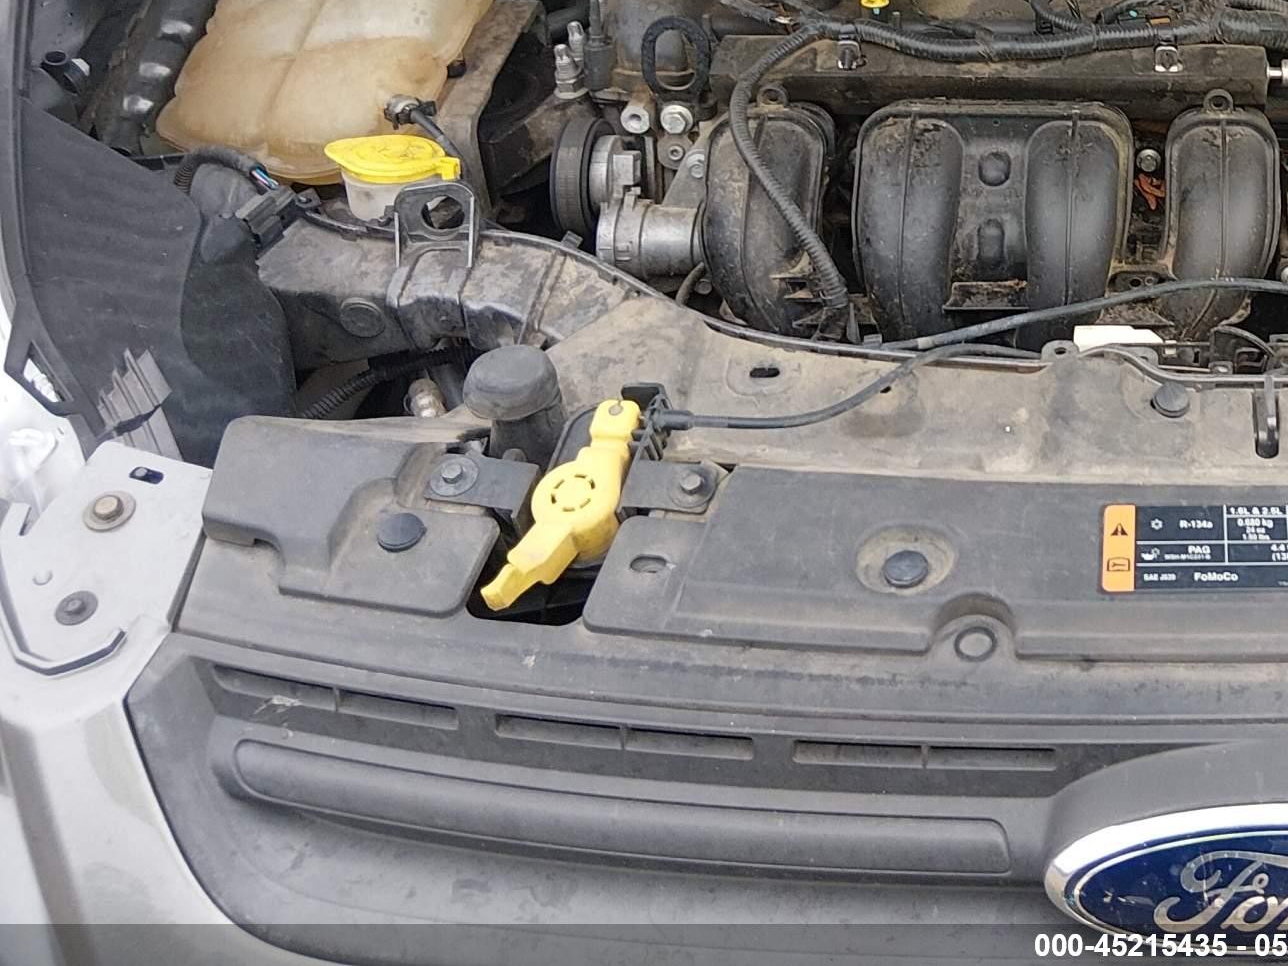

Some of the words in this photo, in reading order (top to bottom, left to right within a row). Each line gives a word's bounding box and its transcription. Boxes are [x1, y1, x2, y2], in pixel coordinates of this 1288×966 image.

[1179, 519, 1214, 529] R-134a
[1188, 545, 1211, 554] PAG
[1194, 572, 1239, 582] FoMoCo
